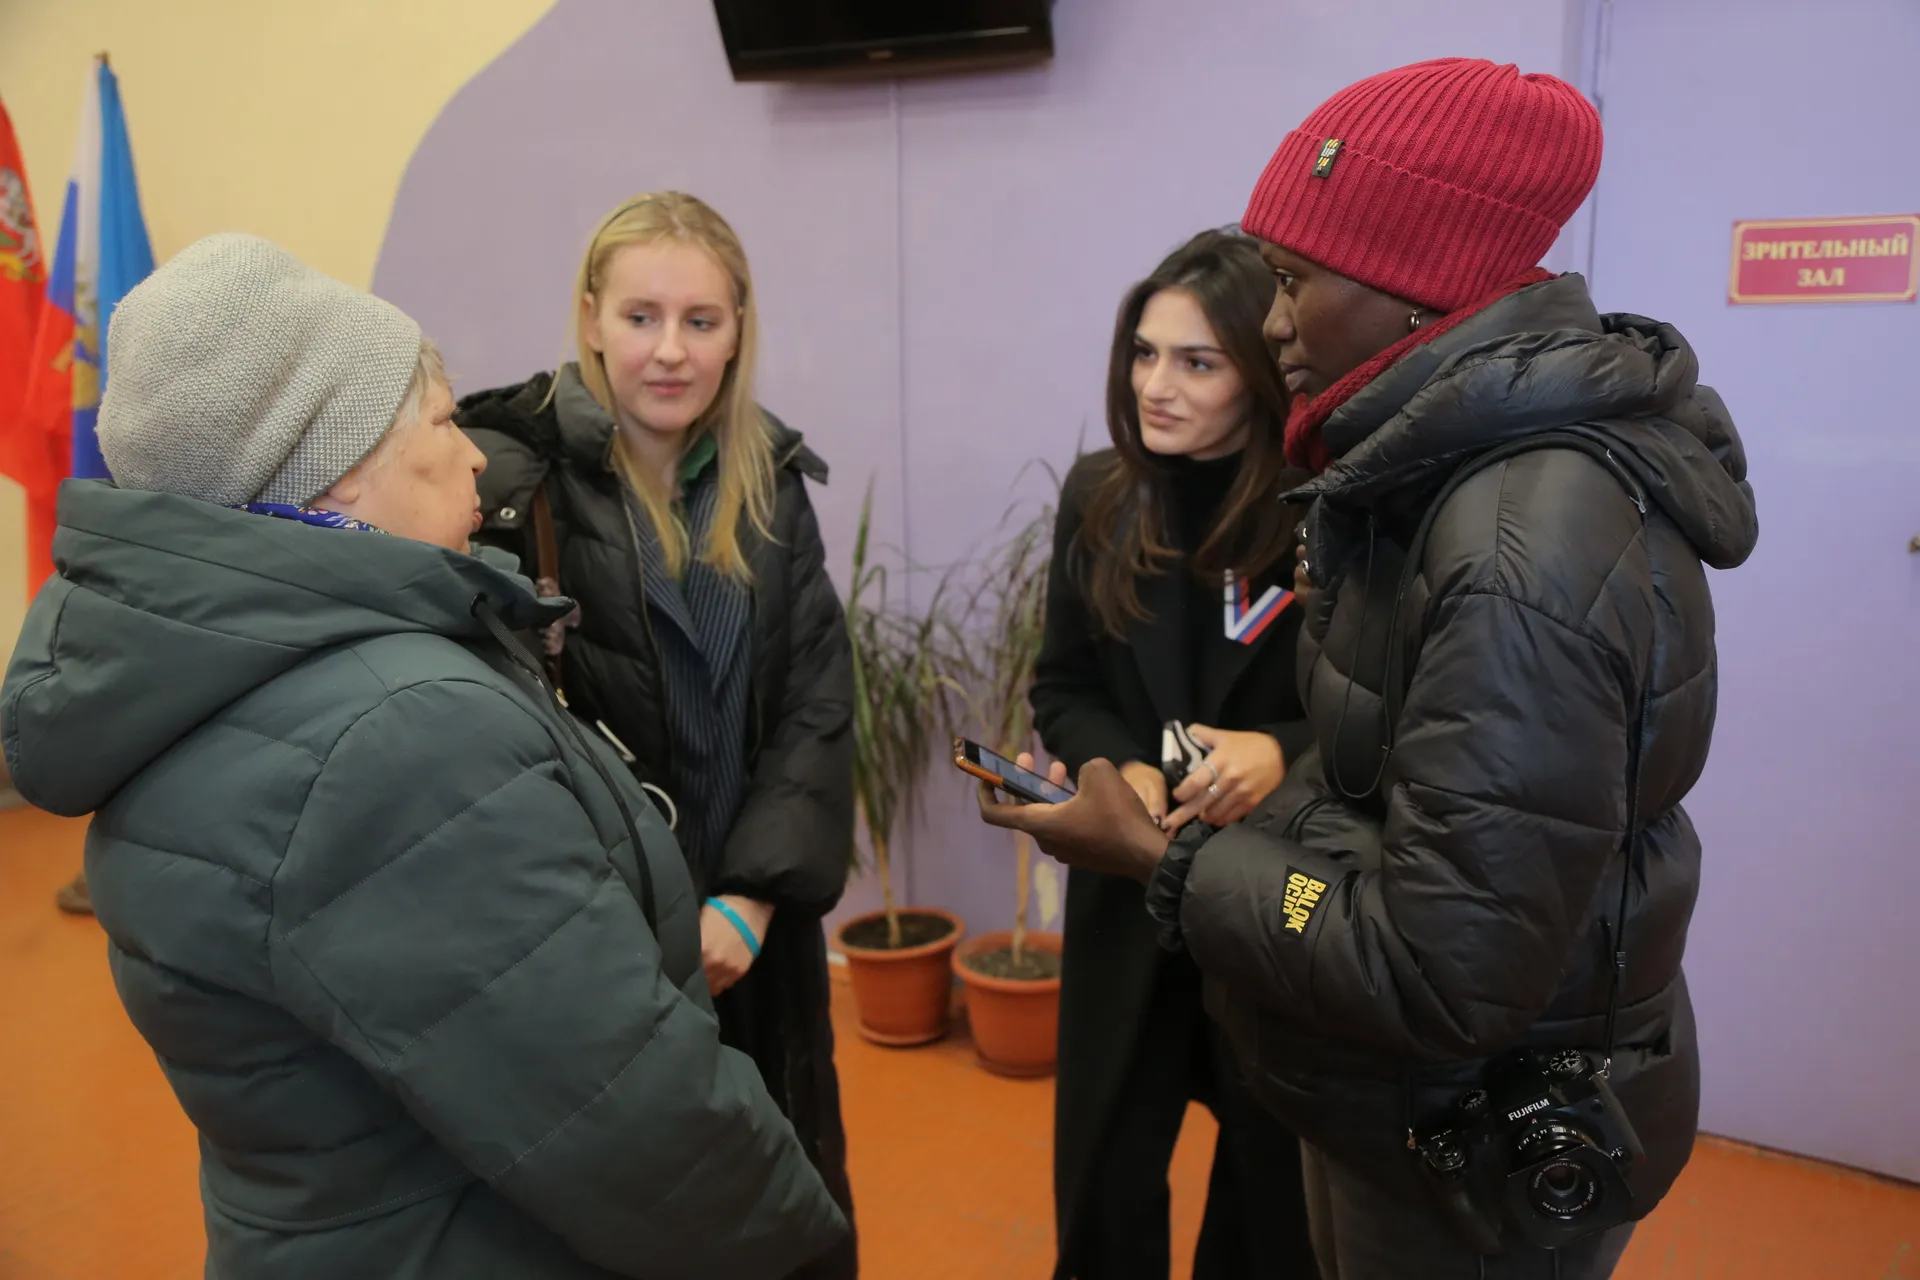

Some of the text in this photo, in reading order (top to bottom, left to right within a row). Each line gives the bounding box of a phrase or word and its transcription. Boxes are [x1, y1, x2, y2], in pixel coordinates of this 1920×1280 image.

[1742, 231, 1909, 261] ЗРИТЕЛЬНЫЙ
[1797, 267, 1846, 287] ЗАЛ
[1284, 878, 1327, 934] BALOK
[1507, 1098, 1550, 1121] FUJIFILM
